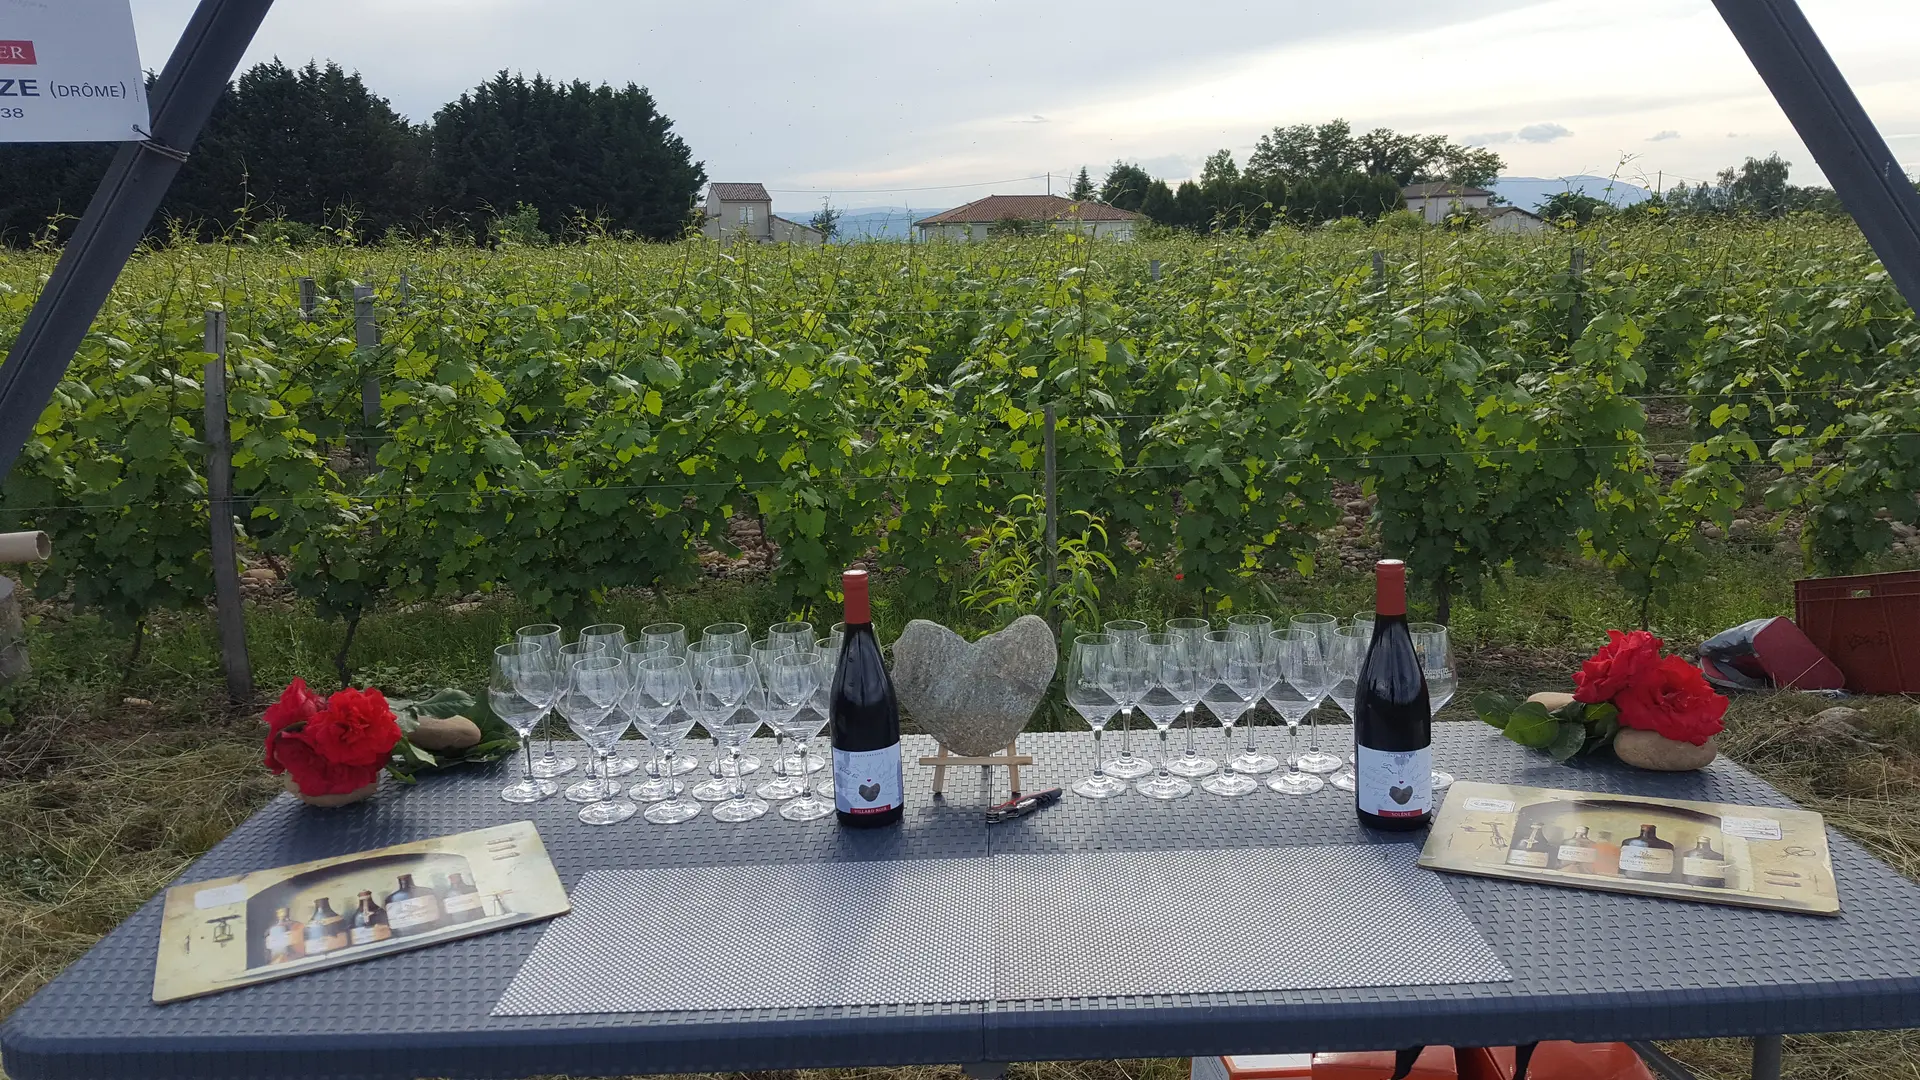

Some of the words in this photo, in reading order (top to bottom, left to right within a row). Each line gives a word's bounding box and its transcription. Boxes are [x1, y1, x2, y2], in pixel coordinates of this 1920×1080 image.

[0, 79, 40, 97] ZE
[50, 81, 126, 99] (DRÔME)
[1, 107, 24, 119] 38
